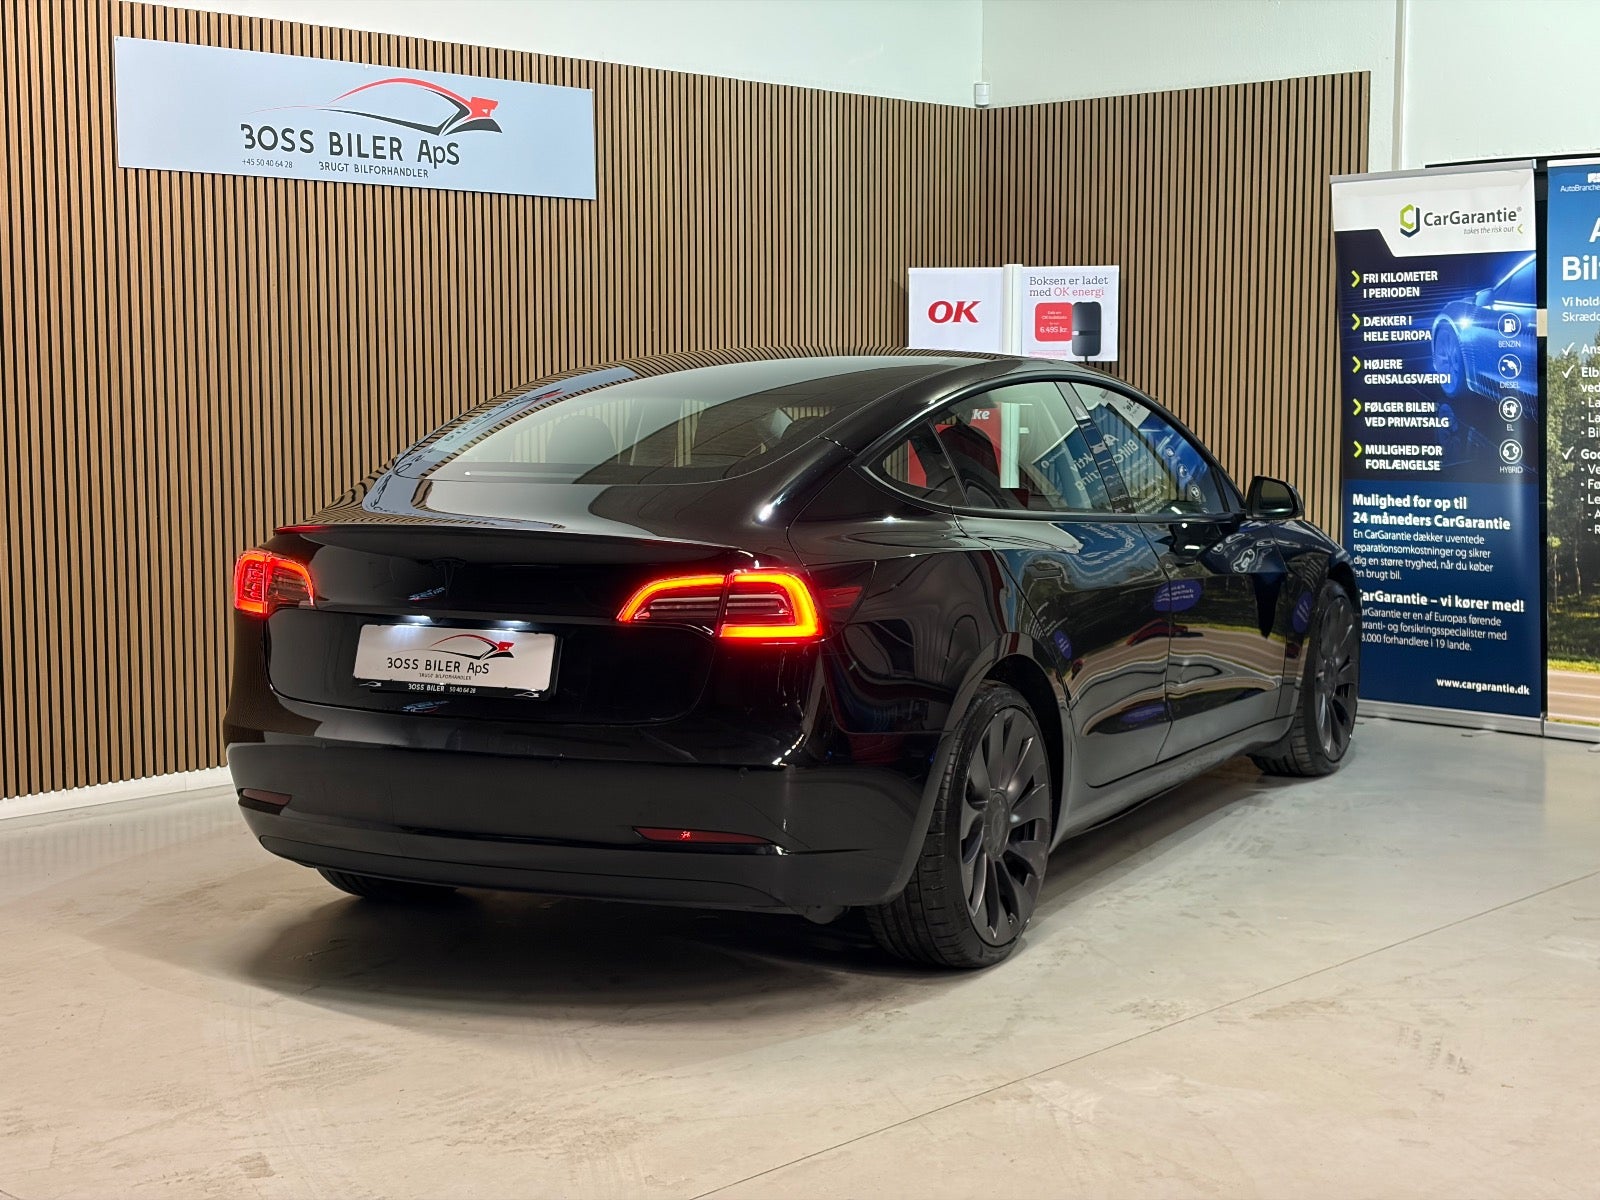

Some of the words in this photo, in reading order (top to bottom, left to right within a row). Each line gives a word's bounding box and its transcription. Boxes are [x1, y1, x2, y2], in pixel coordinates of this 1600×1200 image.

[329, 131, 403, 161] BILER
[417, 139, 460, 169] ApS
[242, 158, 255, 166] +45
[256, 158, 264, 167] 50
[266, 159, 273, 167] 40
[275, 160, 283, 168] 64
[284, 160, 293, 169] 28
[354, 163, 429, 178] BILFORHANDLER
[1464, 227, 1479, 235] takes
[1481, 226, 1490, 234] the
[1491, 225, 1502, 233] risk
[1562, 254, 1600, 280] Bil
[1029, 276, 1066, 285] Boksen
[1082, 276, 1109, 285] ladet
[1363, 273, 1378, 284] FRI
[1380, 270, 1438, 283] KILOMETER
[1029, 288, 1052, 296] med
[1054, 287, 1070, 296] OK
[1072, 287, 1104, 298] energi
[1363, 289, 1367, 298] I
[1369, 286, 1420, 298] PERIODEN
[1562, 296, 1573, 307] Vi
[928, 300, 981, 323] OK
[1363, 315, 1407, 327] DÆKKER
[1408, 315, 1412, 326] I
[1363, 331, 1389, 342] HELE
[1390, 330, 1432, 341] EUROPA
[1498, 340, 1521, 348] BENZIN
[1363, 359, 1403, 370] HØJERE
[1364, 373, 1451, 385] GENSALGSVÆRDI
[1364, 402, 1404, 413] FØLGER
[1405, 401, 1435, 413] BILEN
[1364, 416, 1386, 428] VED
[1387, 416, 1450, 428] PRIVATSALG
[1365, 444, 1420, 456] MULIGHED
[1421, 445, 1443, 456] FOR
[1365, 459, 1441, 471] FORLÆNGELSE
[1499, 466, 1523, 474] HYBRID
[1352, 493, 1411, 510] Mulighed
[1413, 494, 1432, 508] for
[1434, 498, 1451, 511] op
[1454, 496, 1467, 510] til
[1352, 511, 1368, 524] 24
[1370, 511, 1432, 527] måneders
[1434, 514, 1511, 530] CarGarantie
[1353, 528, 1363, 539] En
[1364, 529, 1412, 541] CarGarantie
[1412, 531, 1444, 542] dækker
[1445, 534, 1485, 545] uventede
[1353, 543, 1454, 558] reparationsomkostninger
[1455, 549, 1467, 560] og
[1468, 547, 1491, 559] sikrer
[1353, 555, 1367, 567] dig
[1368, 558, 1379, 566] en
[1380, 557, 1404, 567] større
[1405, 558, 1439, 570] tryghed,
[1440, 559, 1454, 570] når
[1455, 560, 1467, 571] du
[1469, 561, 1494, 572] køber
[1366, 568, 1388, 581] brugt
[1390, 569, 1402, 580] bil.
[1360, 589, 1428, 605] arGarantie
[1440, 595, 1452, 607] vi
[1454, 595, 1489, 610] kører
[1492, 599, 1525, 613] med!
[1362, 607, 1401, 619] arGarantie
[1402, 611, 1410, 619] er
[1424, 611, 1433, 621] af
[1434, 611, 1467, 624] Europas
[1468, 614, 1502, 627] førende
[1387, 623, 1399, 633] og
[1400, 622, 1486, 639] forsikringsspecialister
[1487, 630, 1507, 640] med
[1383, 633, 1429, 647] forhandlere
[1435, 638, 1446, 649] 19
[1446, 639, 1472, 651] lande.
[425, 659, 461, 673] BILER
[466, 661, 490, 676] ApS
[426, 684, 445, 692] BILER
[1436, 678, 1530, 696] www.cargarantie.dk
